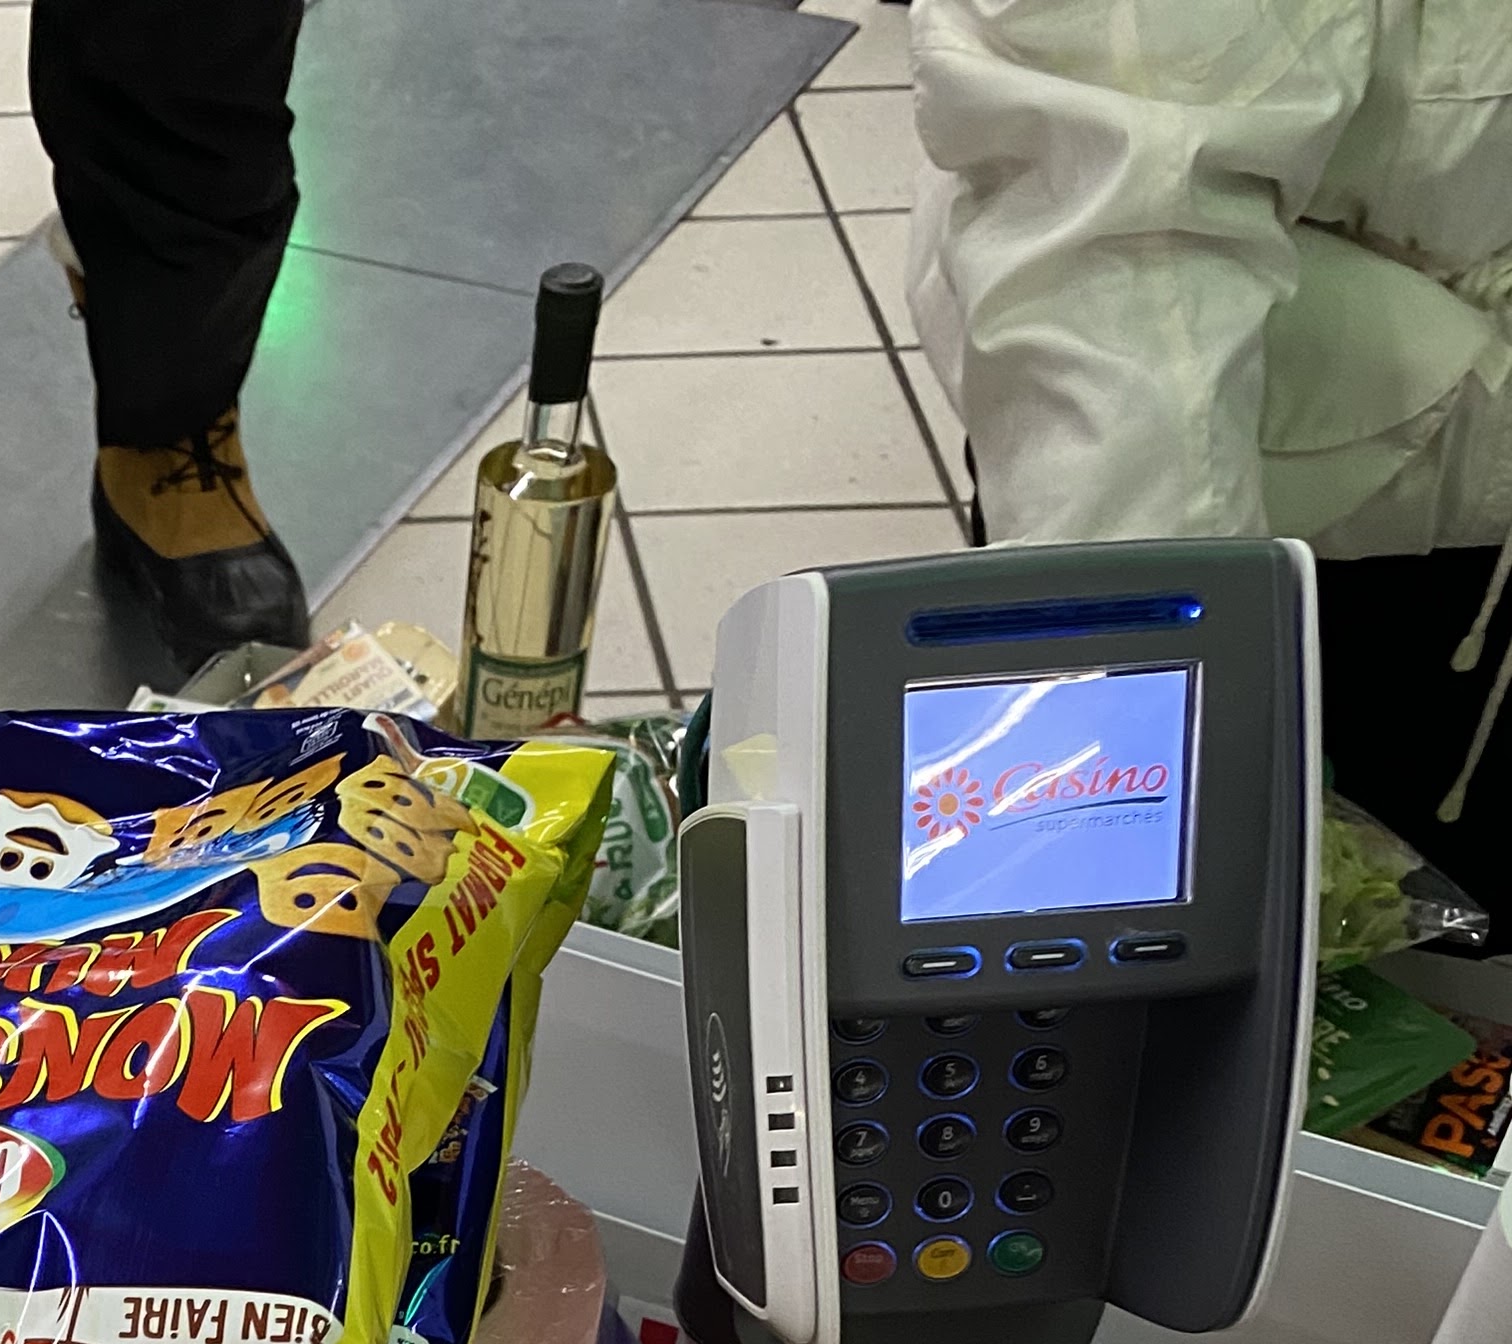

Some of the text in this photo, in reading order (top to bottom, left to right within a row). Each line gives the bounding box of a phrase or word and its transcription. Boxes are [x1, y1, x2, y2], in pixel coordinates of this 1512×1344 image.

[990, 756, 1169, 816] Casino
[1034, 807, 1164, 835] supermarchés
[444, 823, 526, 955] FORMAT
[945, 1062, 955, 1076] 5
[1036, 1055, 1047, 1070] 6
[855, 1071, 865, 1084] 4
[1029, 1117, 1040, 1132] 9
[857, 1132, 867, 1146] 7
[942, 1127, 953, 1140] 8
[938, 1191, 951, 1208] 0
